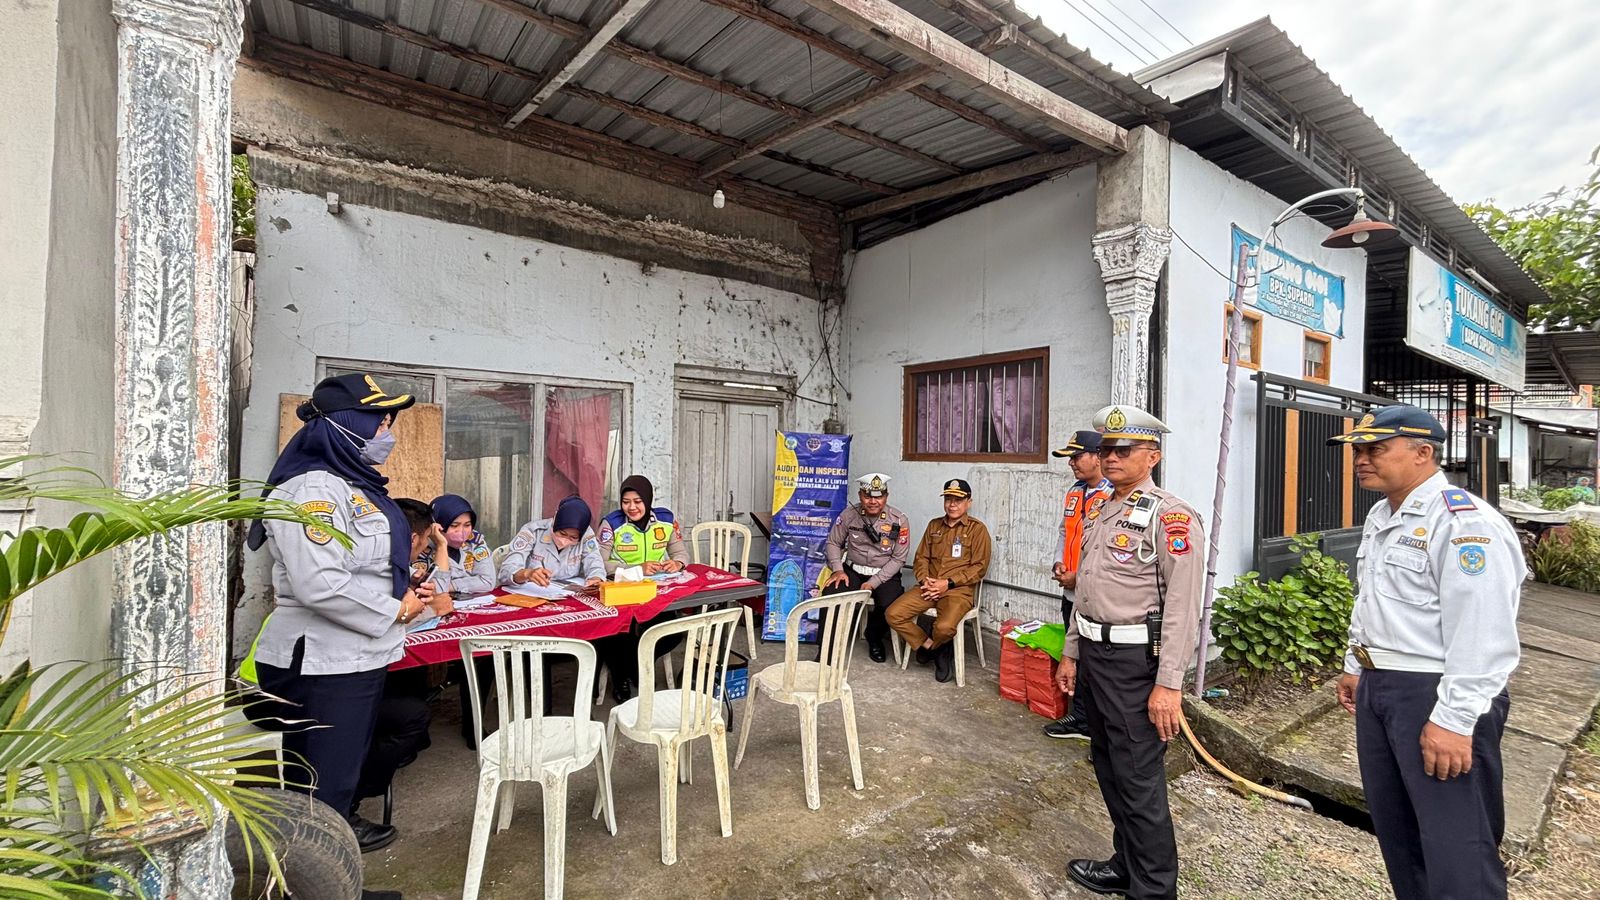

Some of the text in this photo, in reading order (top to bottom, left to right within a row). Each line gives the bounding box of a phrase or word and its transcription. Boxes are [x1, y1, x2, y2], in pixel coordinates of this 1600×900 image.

[1287, 283, 1316, 309] SUPARDI
[1454, 283, 1505, 341] TUKANG GIGI
[776, 464, 848, 476] AUDIT DAN INSPEKSI
